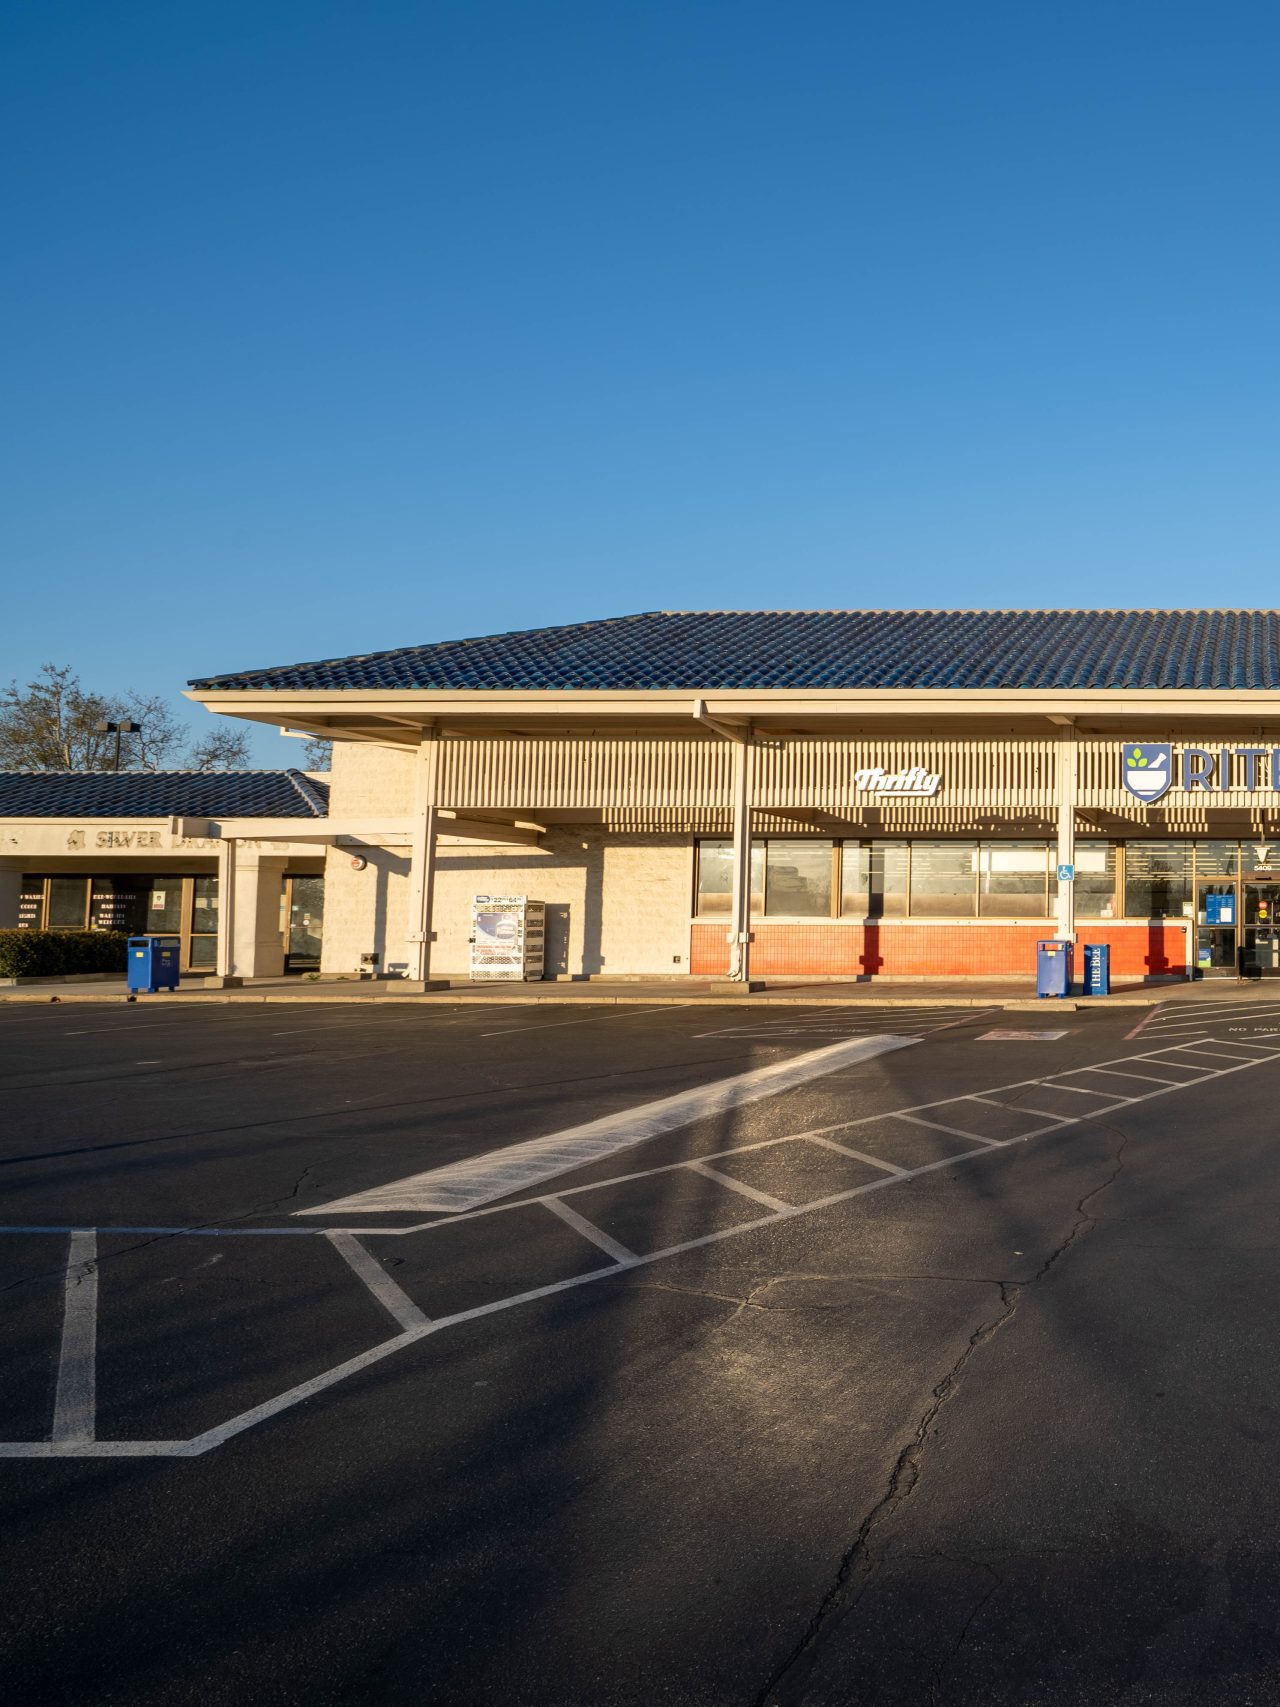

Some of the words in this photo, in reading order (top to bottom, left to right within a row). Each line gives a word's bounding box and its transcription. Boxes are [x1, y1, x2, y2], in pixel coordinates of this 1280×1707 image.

[855, 767, 942, 796] Thrifty
[96, 831, 163, 848] SILVER
[1090, 947, 1101, 967] BEE
[1090, 967, 1101, 987] THE
